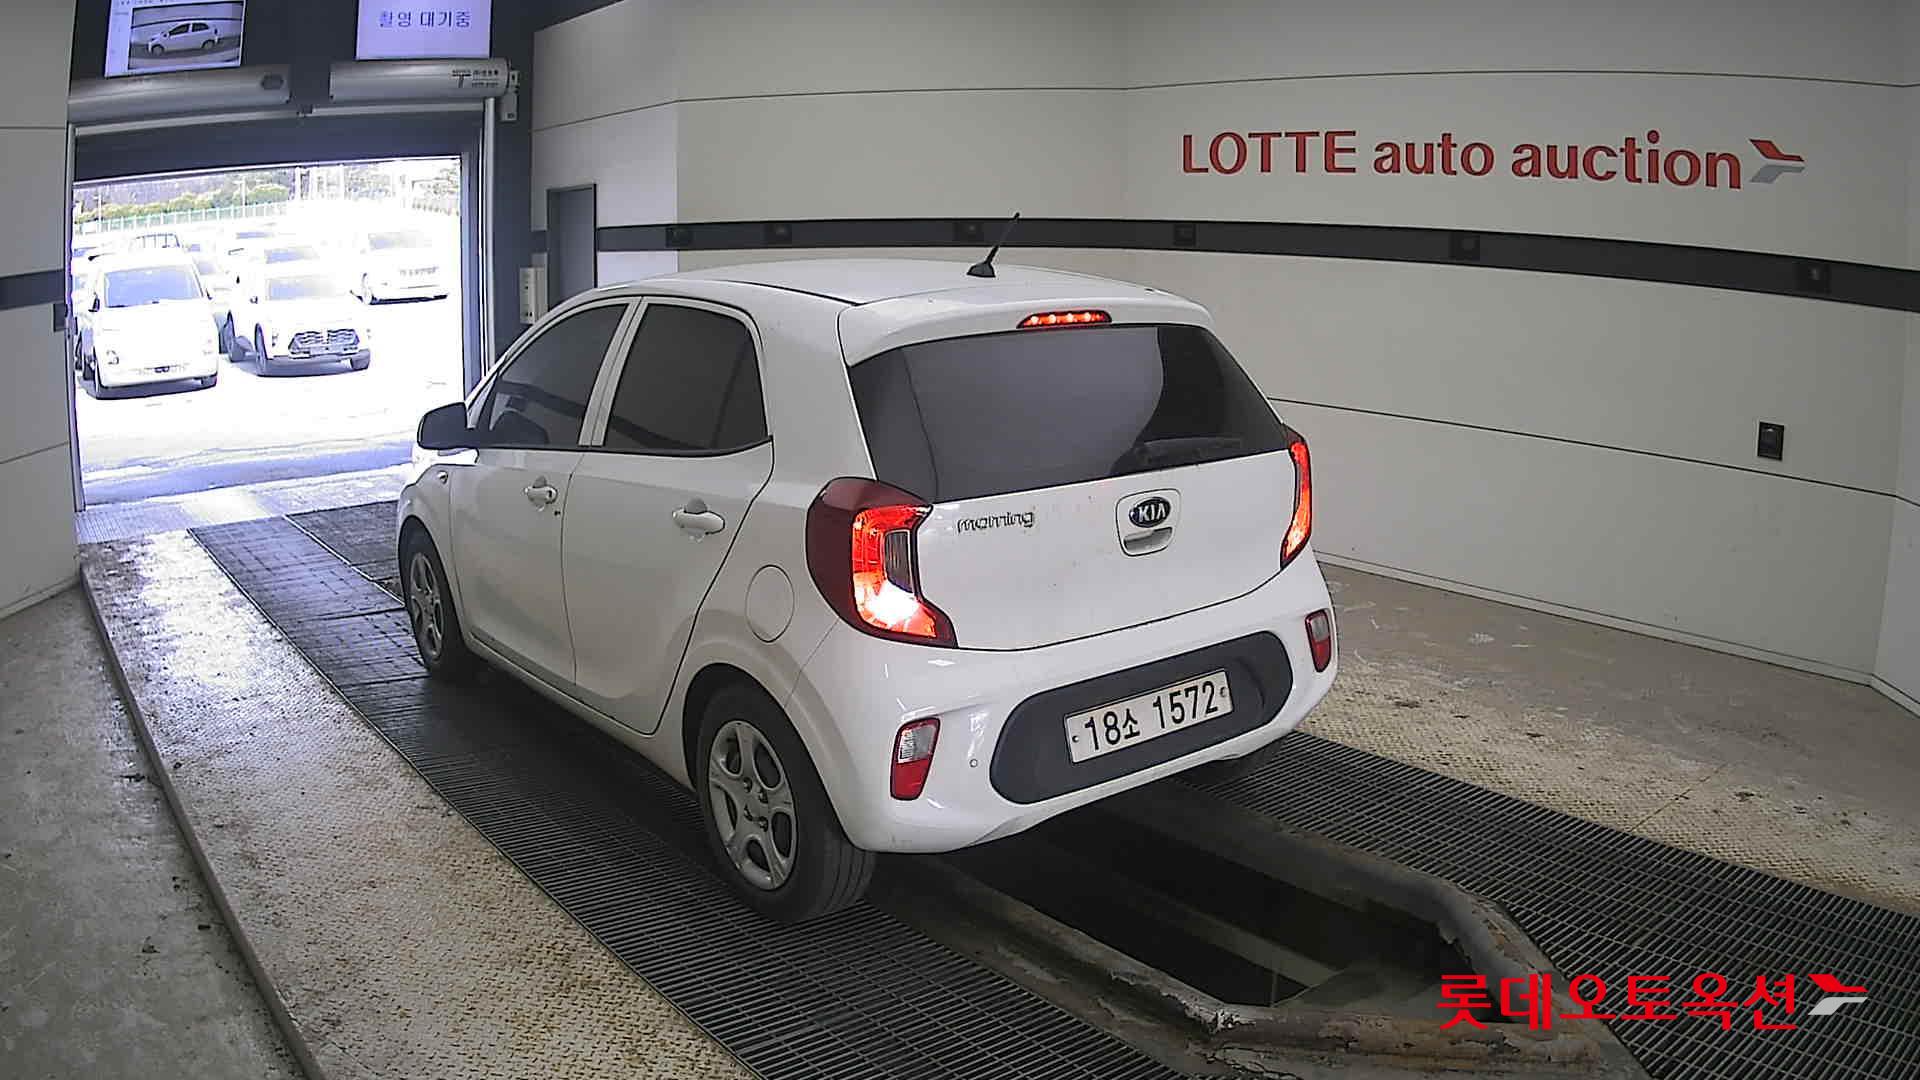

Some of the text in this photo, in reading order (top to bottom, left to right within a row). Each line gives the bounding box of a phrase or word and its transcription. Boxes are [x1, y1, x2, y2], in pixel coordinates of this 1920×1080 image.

[419, 11, 471, 28] 대기중
[1183, 130, 1742, 189] LOTTE auto auction
[957, 511, 1034, 534] morning
[1136, 500, 1167, 522] KIA
[1084, 680, 1219, 751] 18소 1572
